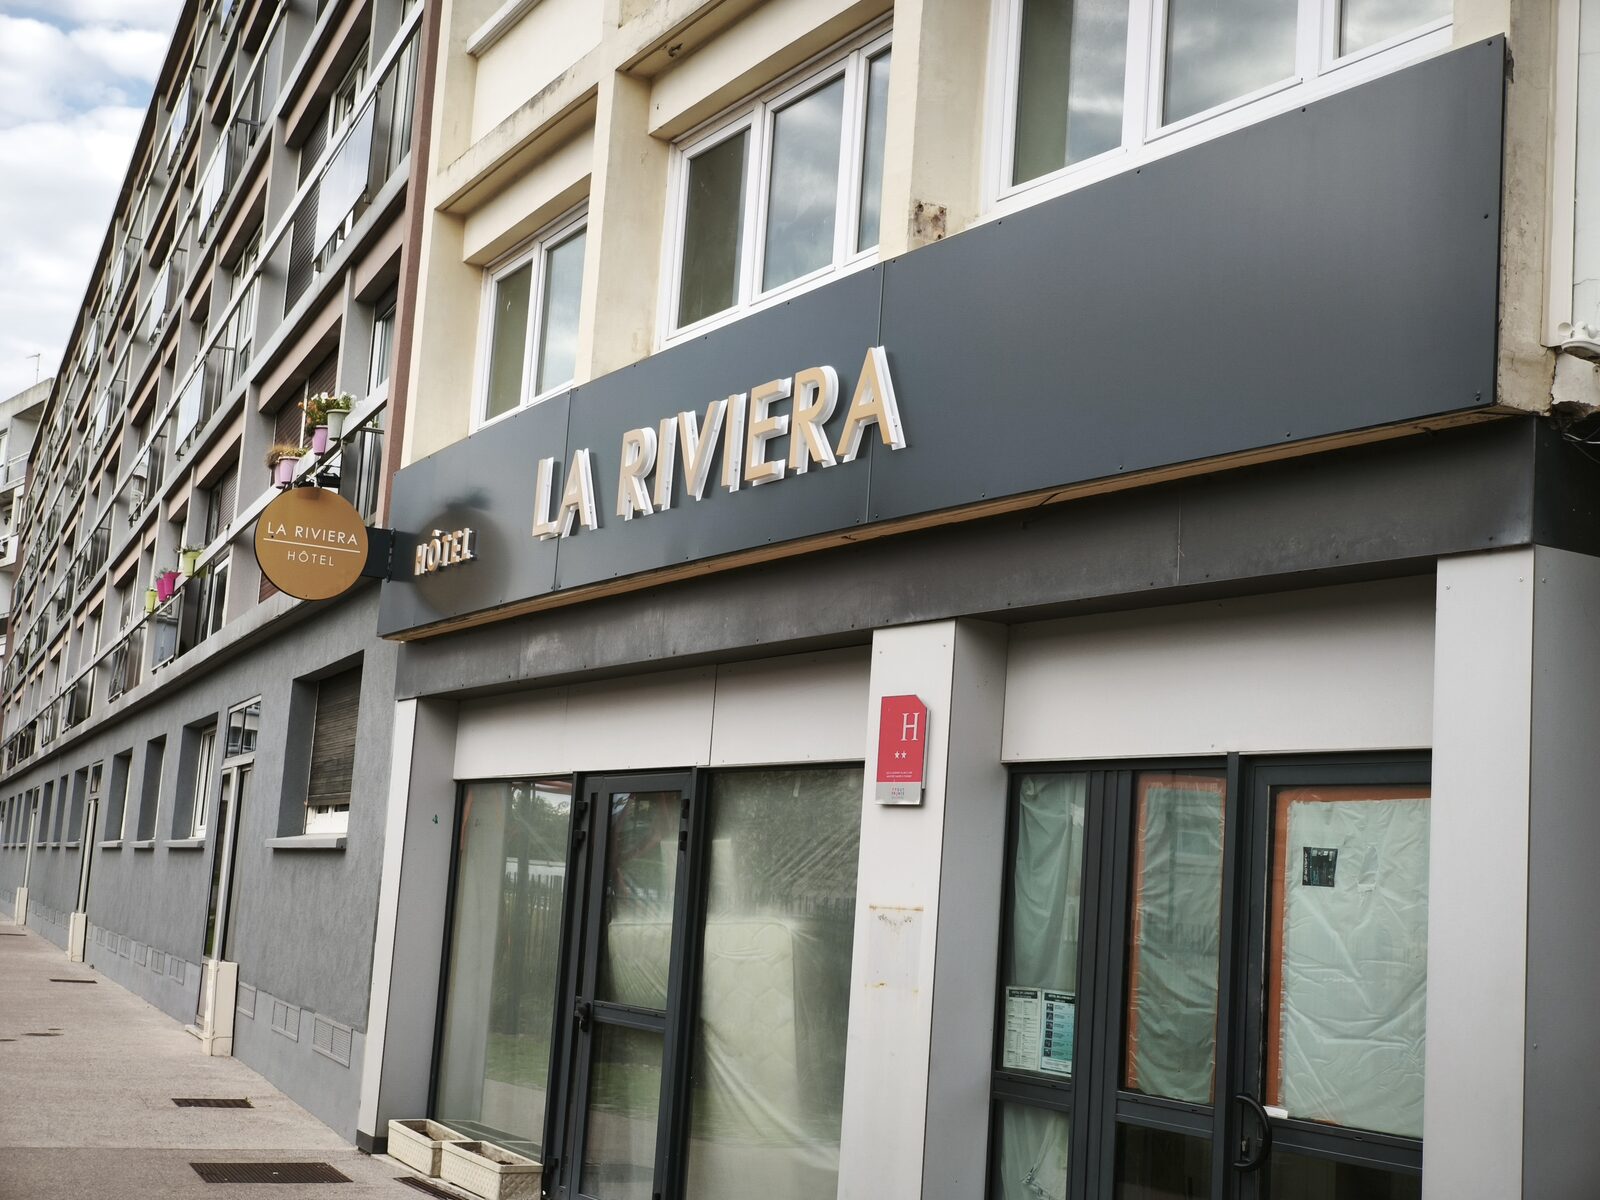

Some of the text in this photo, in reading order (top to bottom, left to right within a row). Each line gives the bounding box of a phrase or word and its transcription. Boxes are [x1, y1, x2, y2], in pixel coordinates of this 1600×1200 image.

[532, 345, 907, 541] LA RIVIERA
[266, 521, 358, 546] LA RIVIERA
[287, 549, 335, 567] HÔTEL
[414, 527, 473, 576] HÔTEL
[901, 712, 920, 741] H
